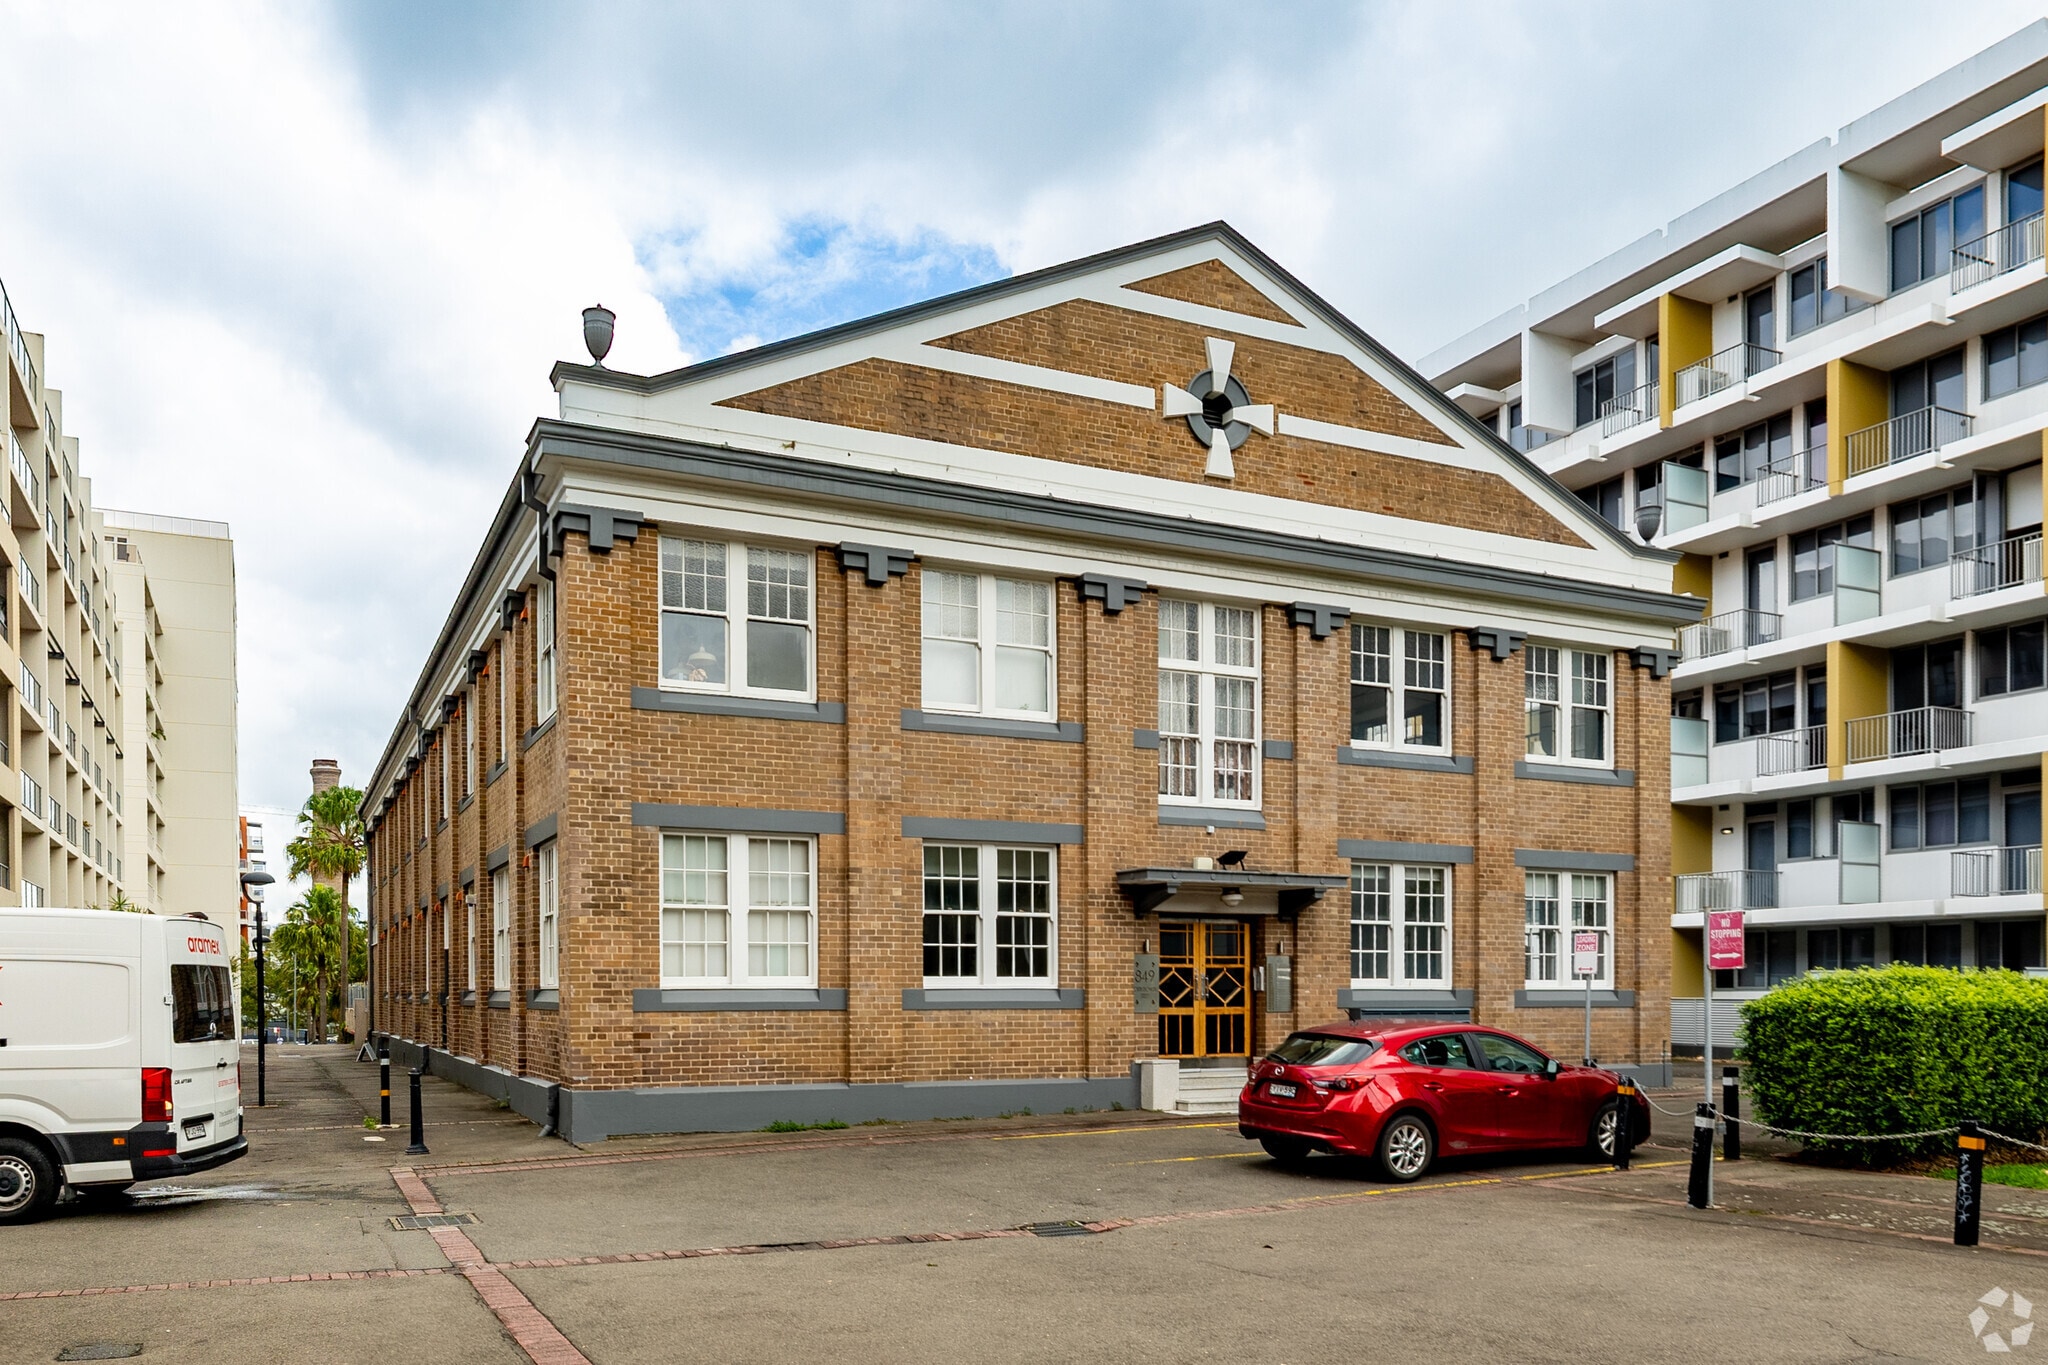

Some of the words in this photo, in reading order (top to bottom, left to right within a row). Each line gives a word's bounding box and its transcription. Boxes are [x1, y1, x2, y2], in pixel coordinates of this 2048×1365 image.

[1721, 918, 1731, 928] NO
[1710, 928, 1742, 938] STOPPING
[187, 936, 221, 955] aramex
[1576, 944, 1597, 952] ZONE
[1135, 969, 1155, 982] 849
